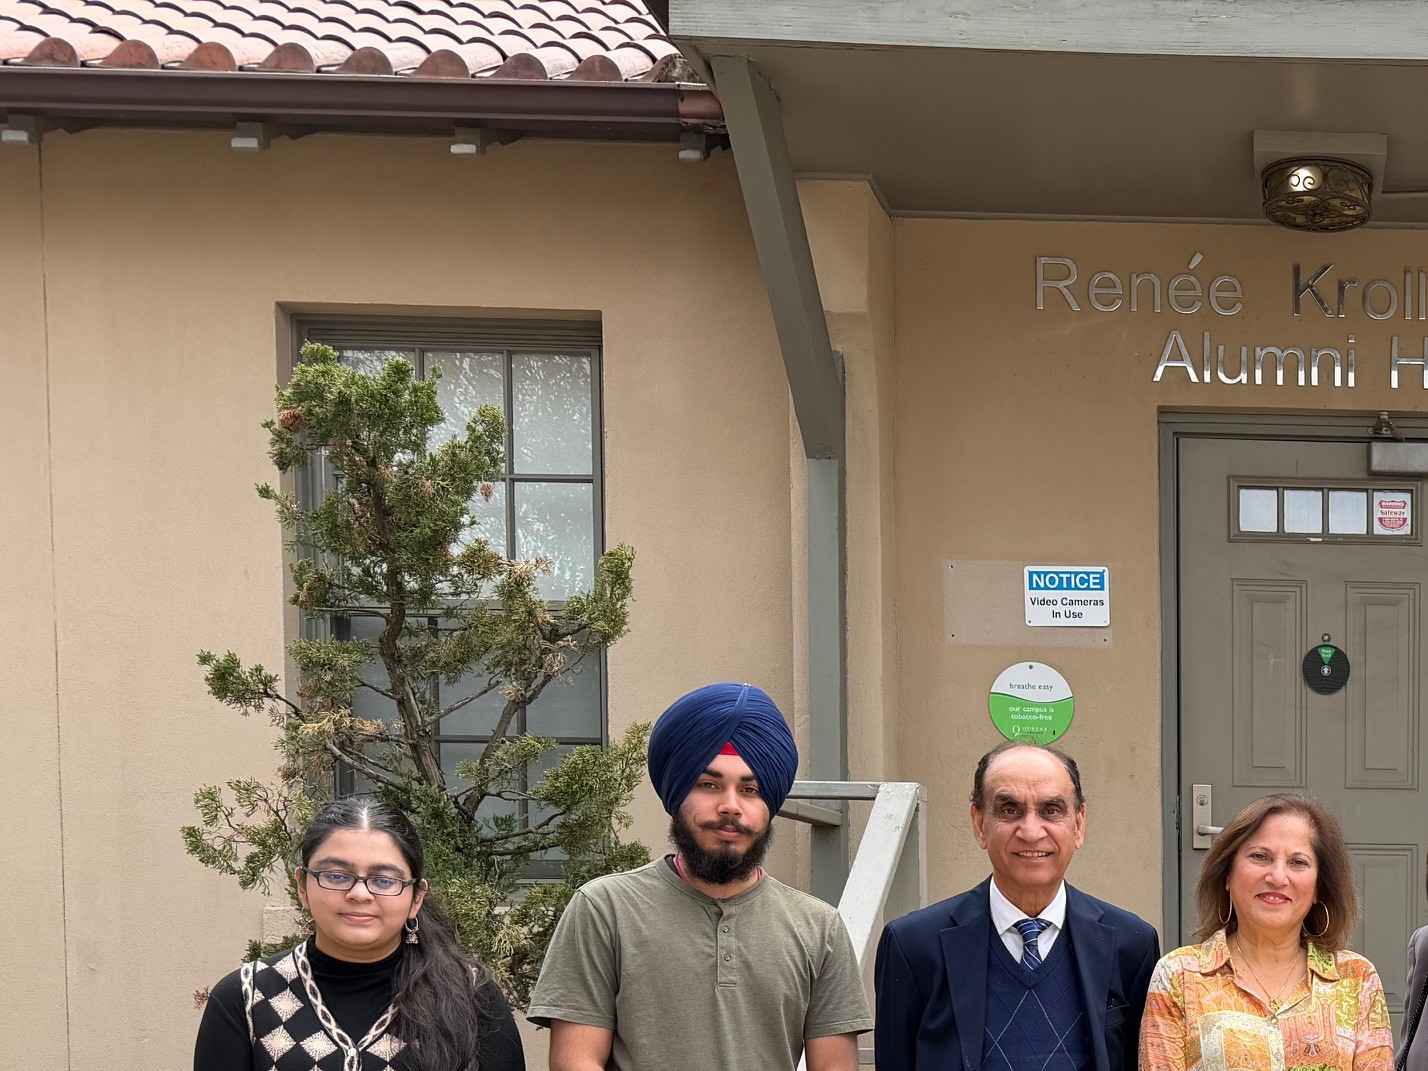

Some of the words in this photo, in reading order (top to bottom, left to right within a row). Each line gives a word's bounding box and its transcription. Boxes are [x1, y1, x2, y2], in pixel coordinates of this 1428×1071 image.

[1035, 252, 1243, 316] Renée
[1292, 262, 1426, 320] Kroll
[1152, 329, 1355, 388] Alumni
[1032, 573, 1101, 589] NOTICE
[1029, 597, 1058, 606] Video
[1060, 597, 1105, 606] Cameras
[1052, 610, 1061, 619] In
[1064, 610, 1083, 619] Use
